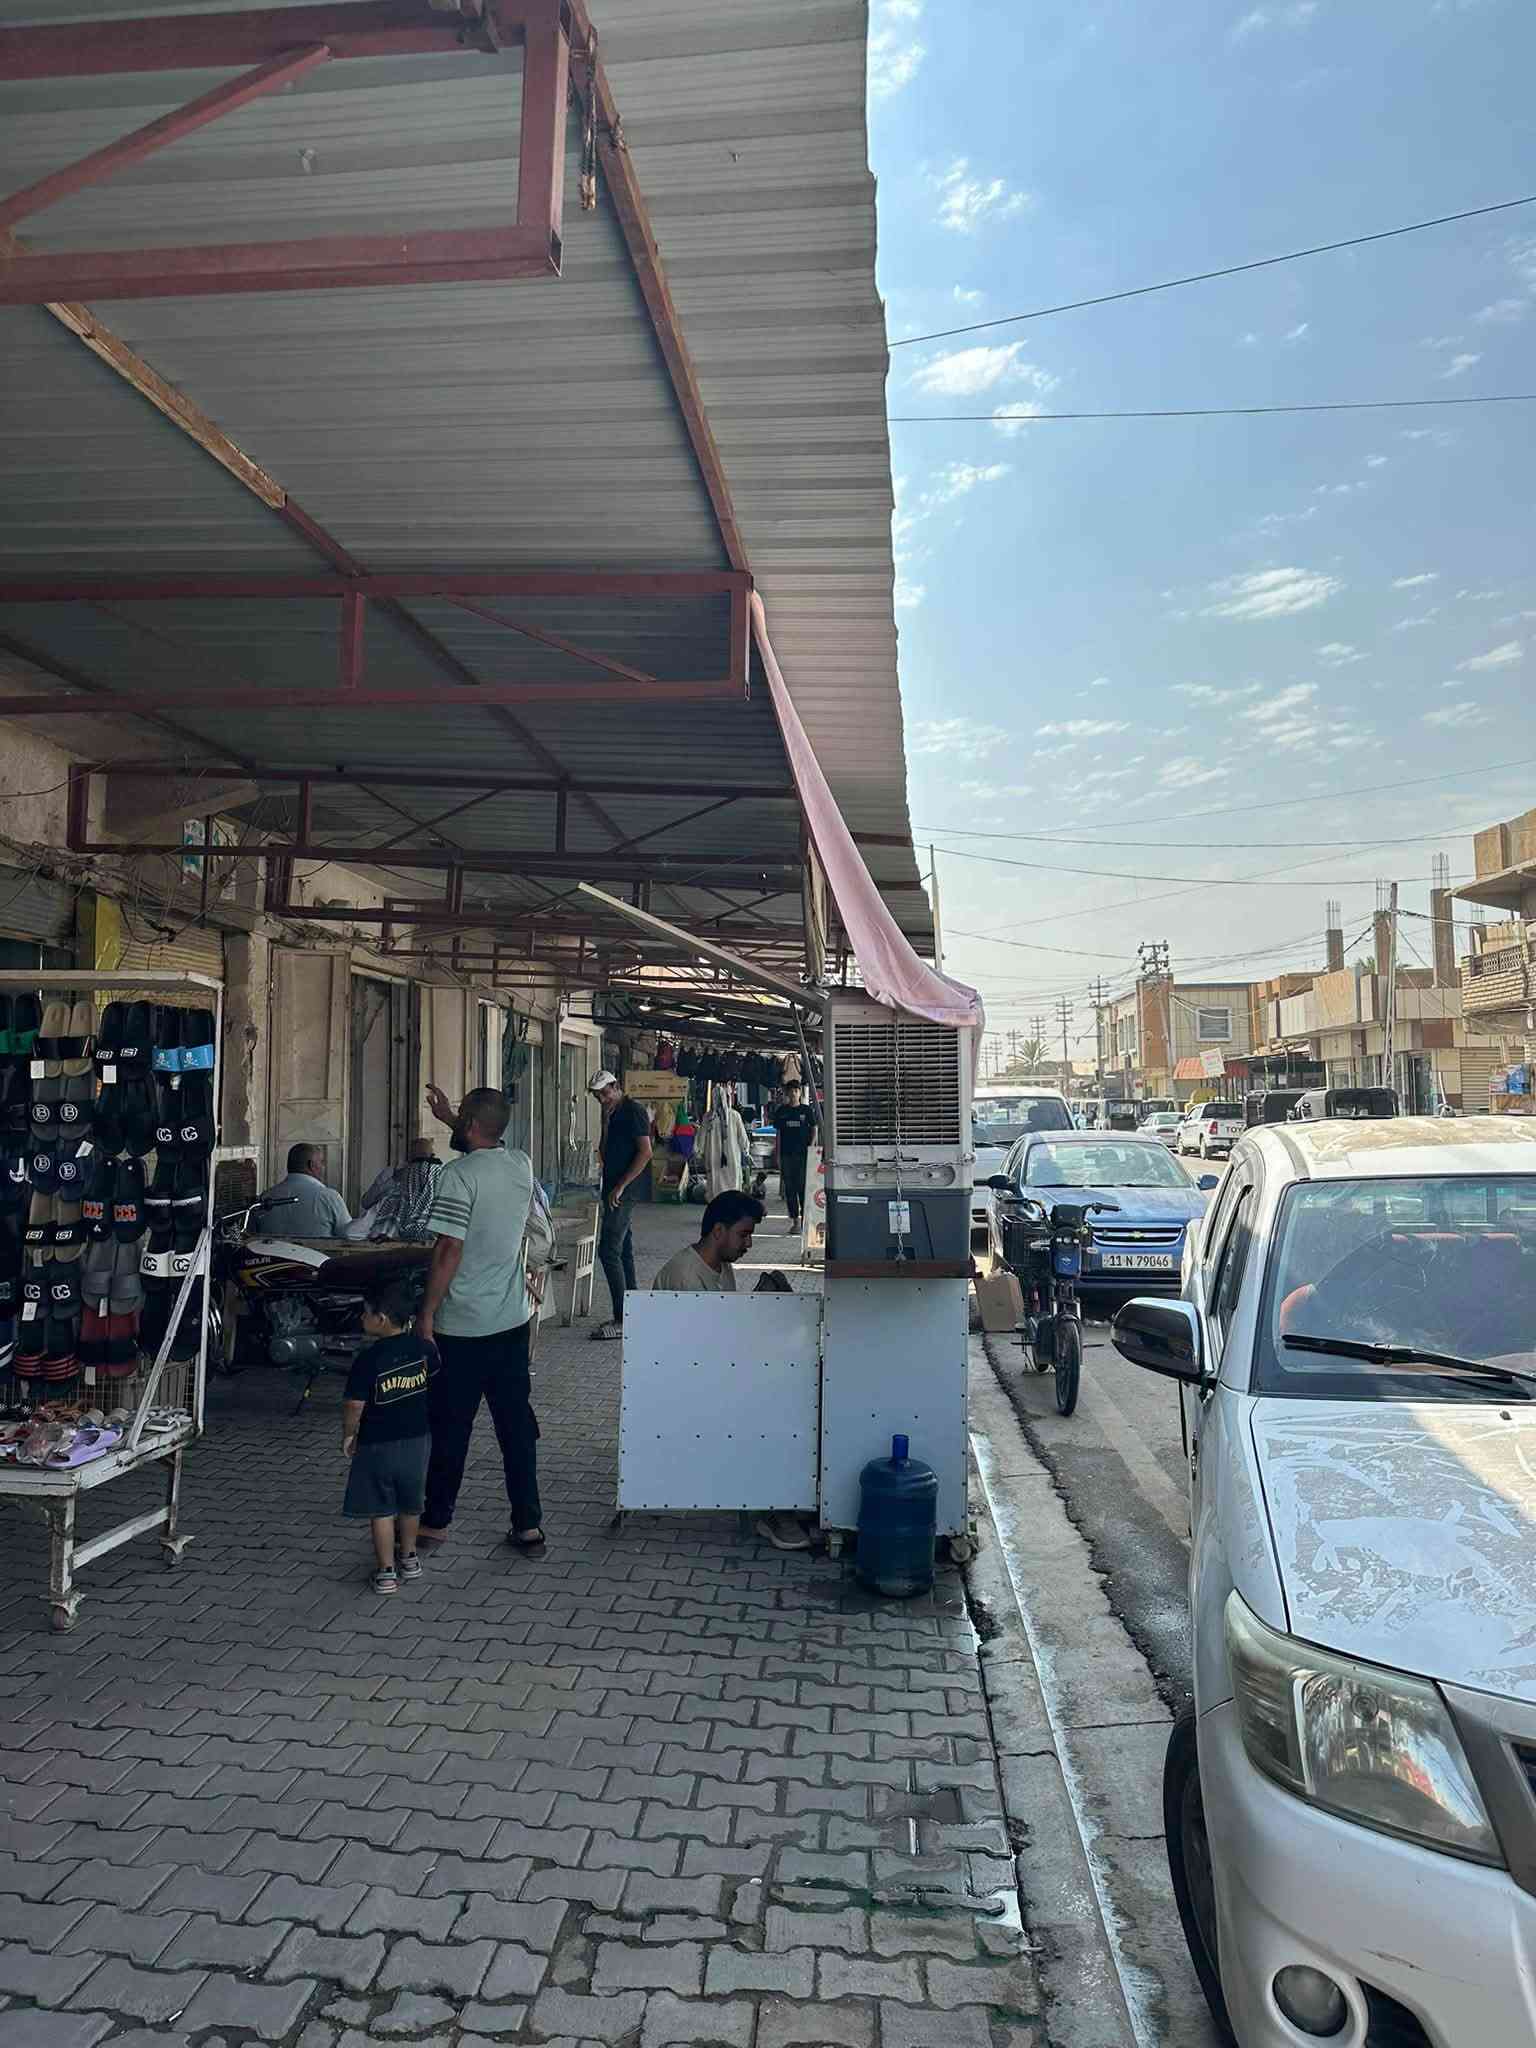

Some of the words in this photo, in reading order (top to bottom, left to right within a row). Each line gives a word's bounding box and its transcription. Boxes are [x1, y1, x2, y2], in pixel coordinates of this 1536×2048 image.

[63, 1106, 76, 1120] B
[37, 1157, 49, 1170] B
[1109, 1255, 1121, 1267] 11
[1126, 1255, 1133, 1267] N
[1136, 1255, 1169, 1267] 79046
